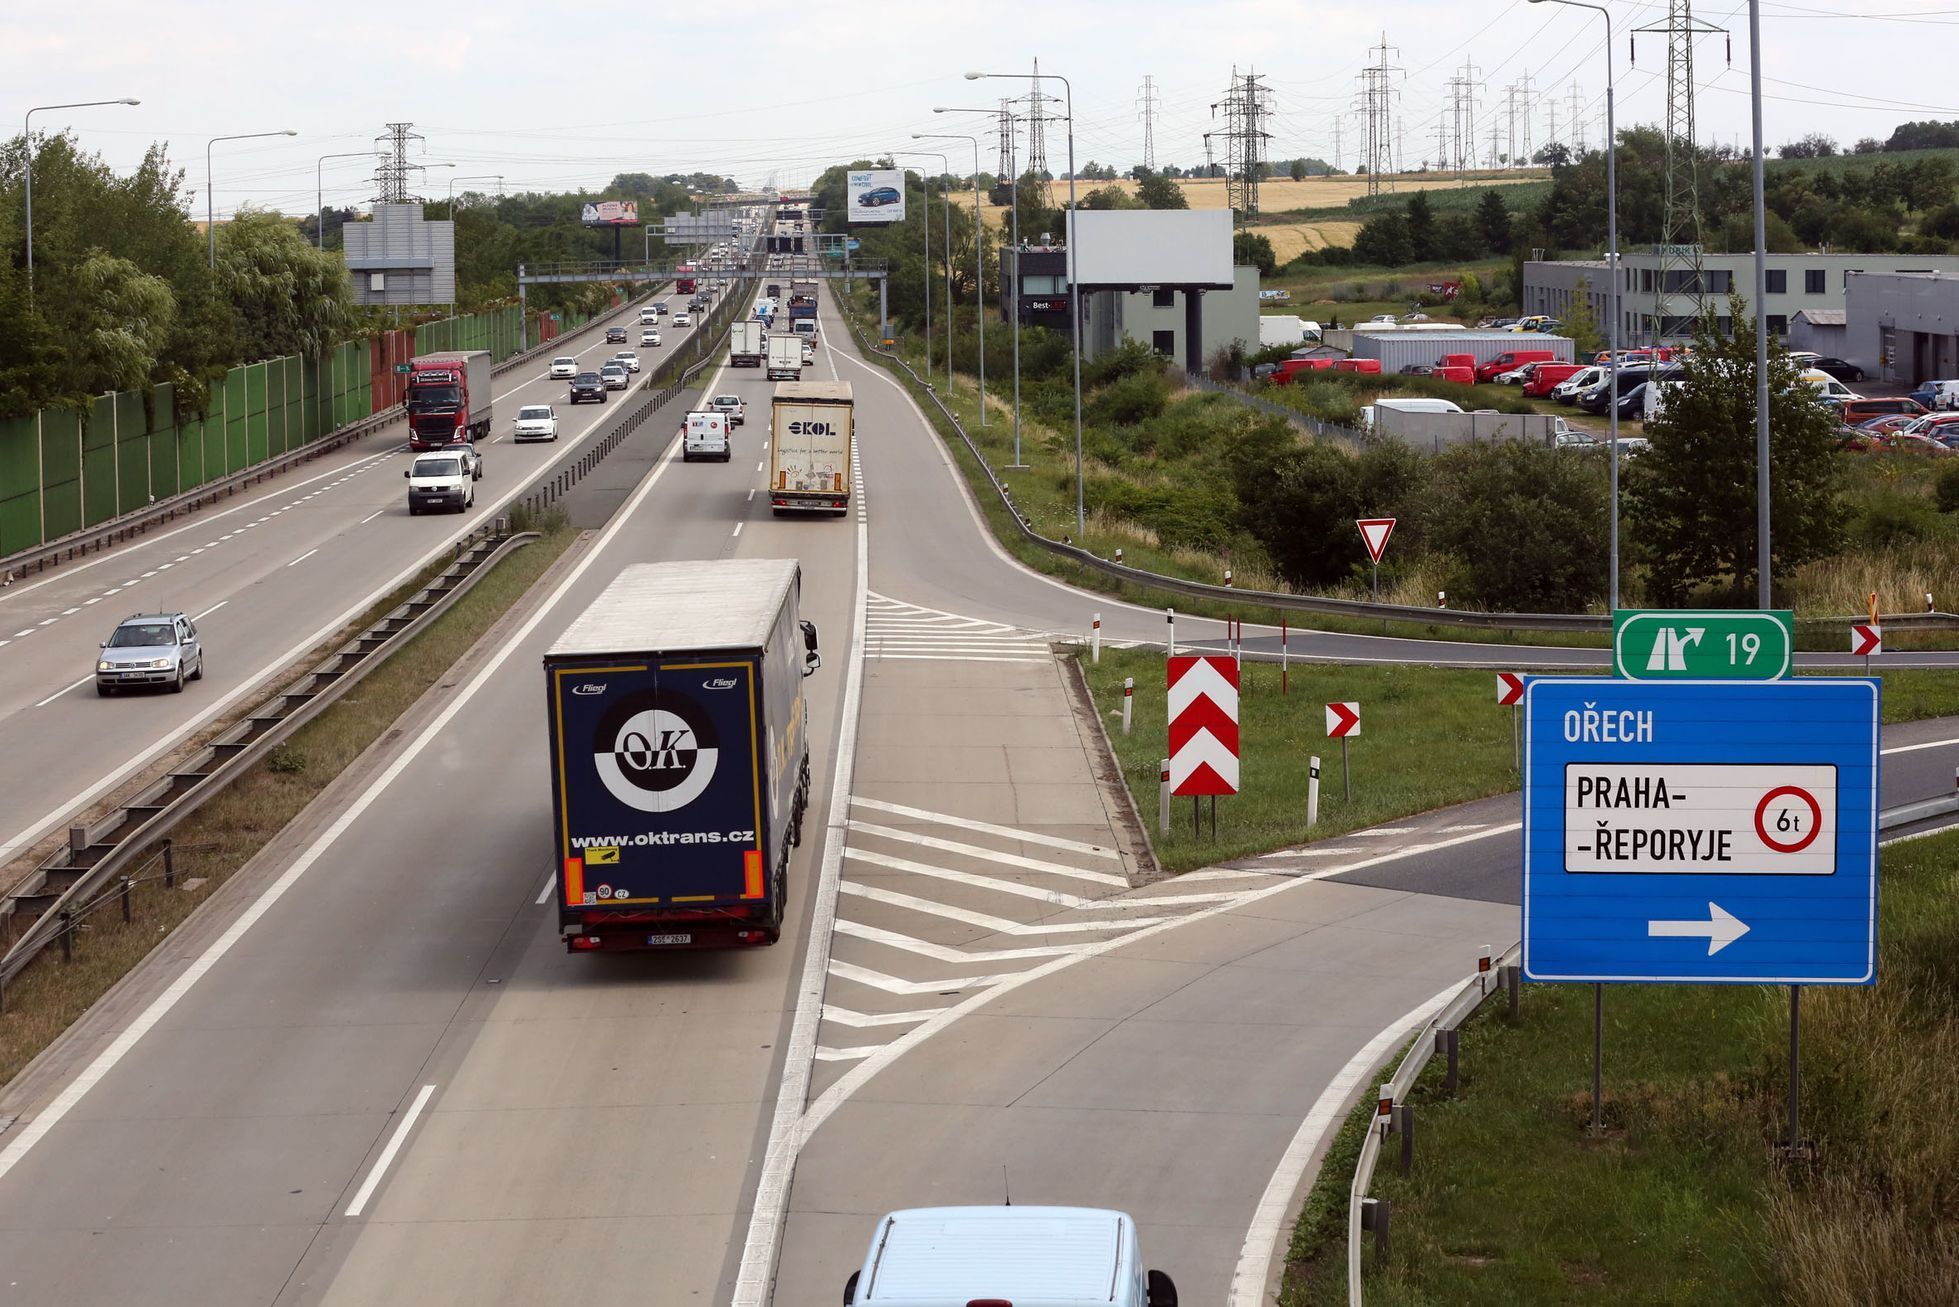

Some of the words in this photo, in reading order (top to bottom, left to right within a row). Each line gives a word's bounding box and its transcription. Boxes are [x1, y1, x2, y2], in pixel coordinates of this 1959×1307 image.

[789, 421, 836, 436] EKOL
[1726, 633, 1760, 665] 19
[582, 683, 607, 693] Fliegl
[712, 678, 737, 688] Fliegl
[1564, 701, 1653, 743] OŘECH
[1577, 776, 1686, 809] PRAHA-
[571, 831, 755, 848] www.oktrans.cz
[1577, 820, 1732, 861] -ŘEPORYJE
[600, 887, 610, 896] 90
